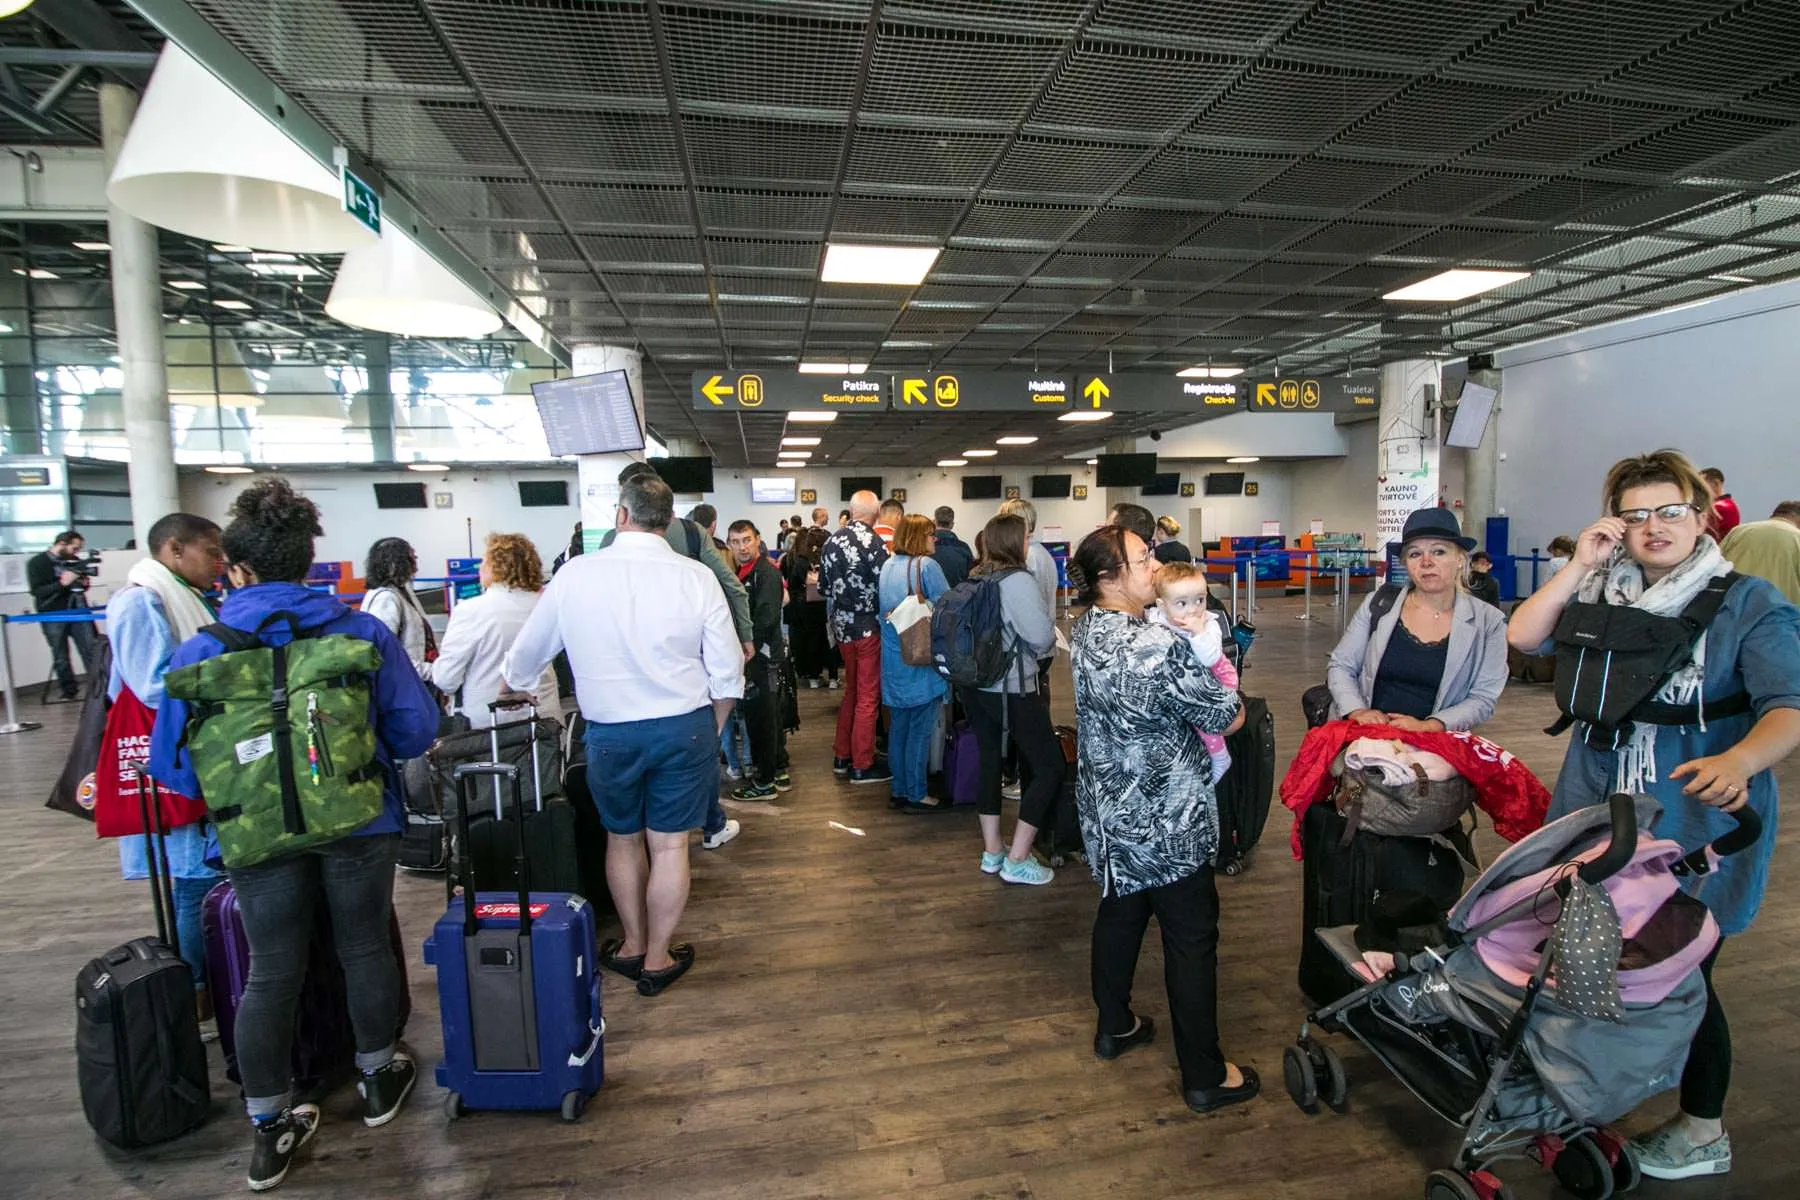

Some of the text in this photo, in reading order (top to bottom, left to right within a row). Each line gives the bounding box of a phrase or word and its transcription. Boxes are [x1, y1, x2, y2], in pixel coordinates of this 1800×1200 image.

[842, 380, 880, 391] Patikra
[1183, 382, 1237, 396] Registracija
[1342, 384, 1376, 394] Tualetai
[822, 393, 880, 404] Security check
[1032, 394, 1066, 403] Customs
[1204, 395, 1236, 405] Check-in
[1354, 396, 1375, 405] Toilets
[1007, 488, 1018, 497] 22
[1075, 487, 1086, 497] 23
[1183, 485, 1194, 494] 24
[1246, 484, 1257, 493] 25
[1384, 484, 1418, 493] KAUNO
[801, 491, 815, 500] 20
[895, 491, 905, 500] 21
[1377, 509, 1397, 517] ORTS
[1377, 518, 1405, 526] AUNAS
[477, 904, 543, 916] Supree
